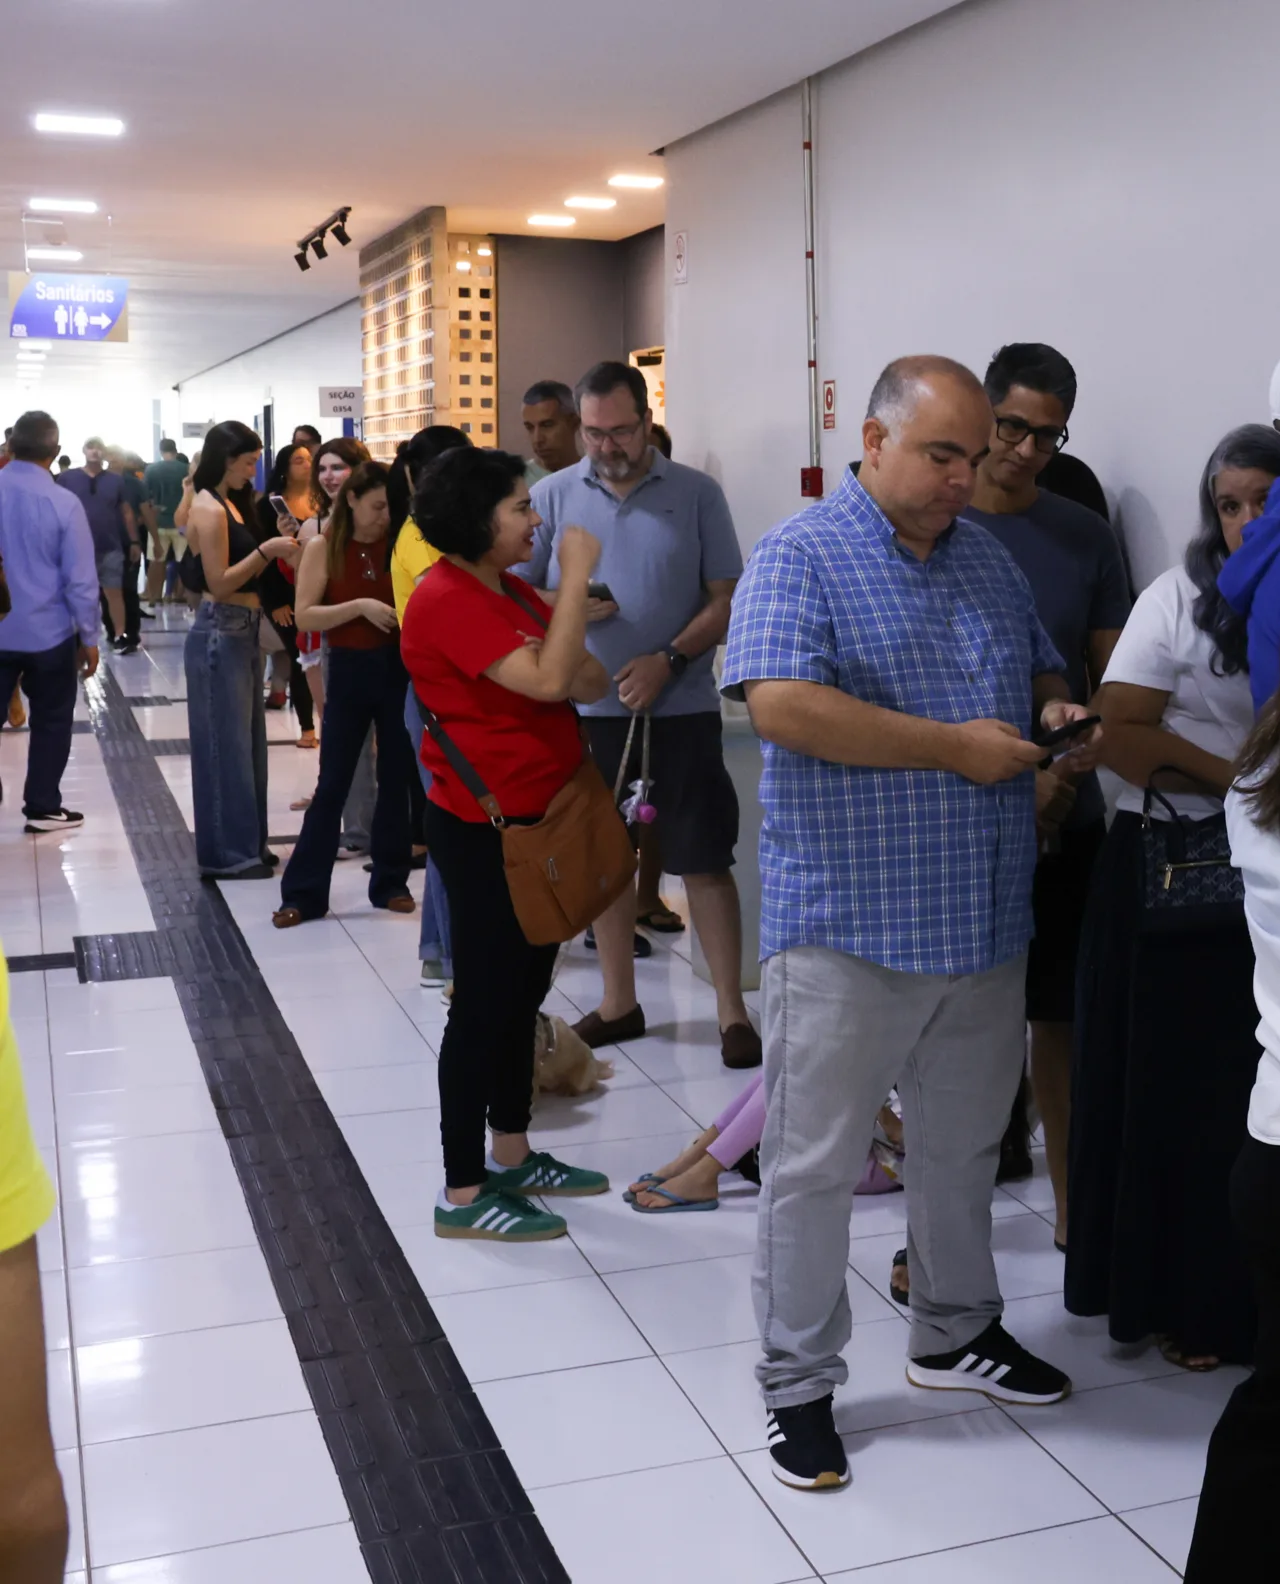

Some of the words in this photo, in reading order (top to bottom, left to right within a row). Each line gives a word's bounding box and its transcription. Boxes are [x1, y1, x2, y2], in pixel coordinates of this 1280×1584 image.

[35, 281, 114, 303] Sanitários
[329, 391, 355, 400] SEÇÃO
[333, 405, 352, 413] 0354
